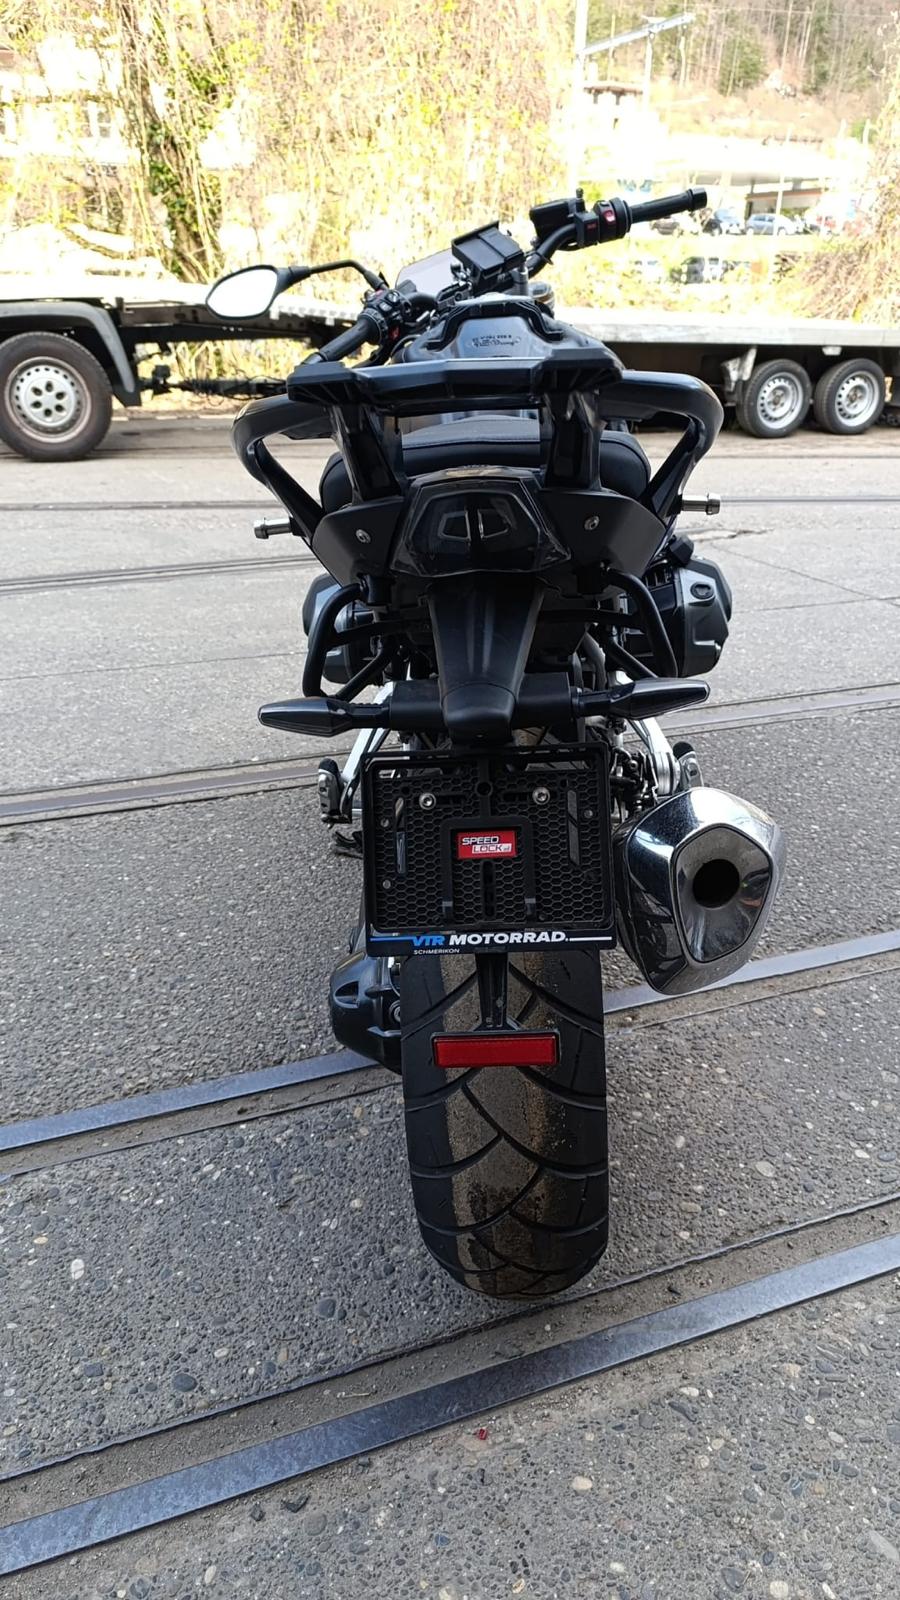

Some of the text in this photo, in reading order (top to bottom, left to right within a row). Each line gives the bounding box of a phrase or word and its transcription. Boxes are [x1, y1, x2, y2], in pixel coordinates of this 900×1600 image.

[462, 836, 499, 845] SPEED
[412, 933, 445, 946] VTR
[413, 947, 460, 955] SCHMERIKON
